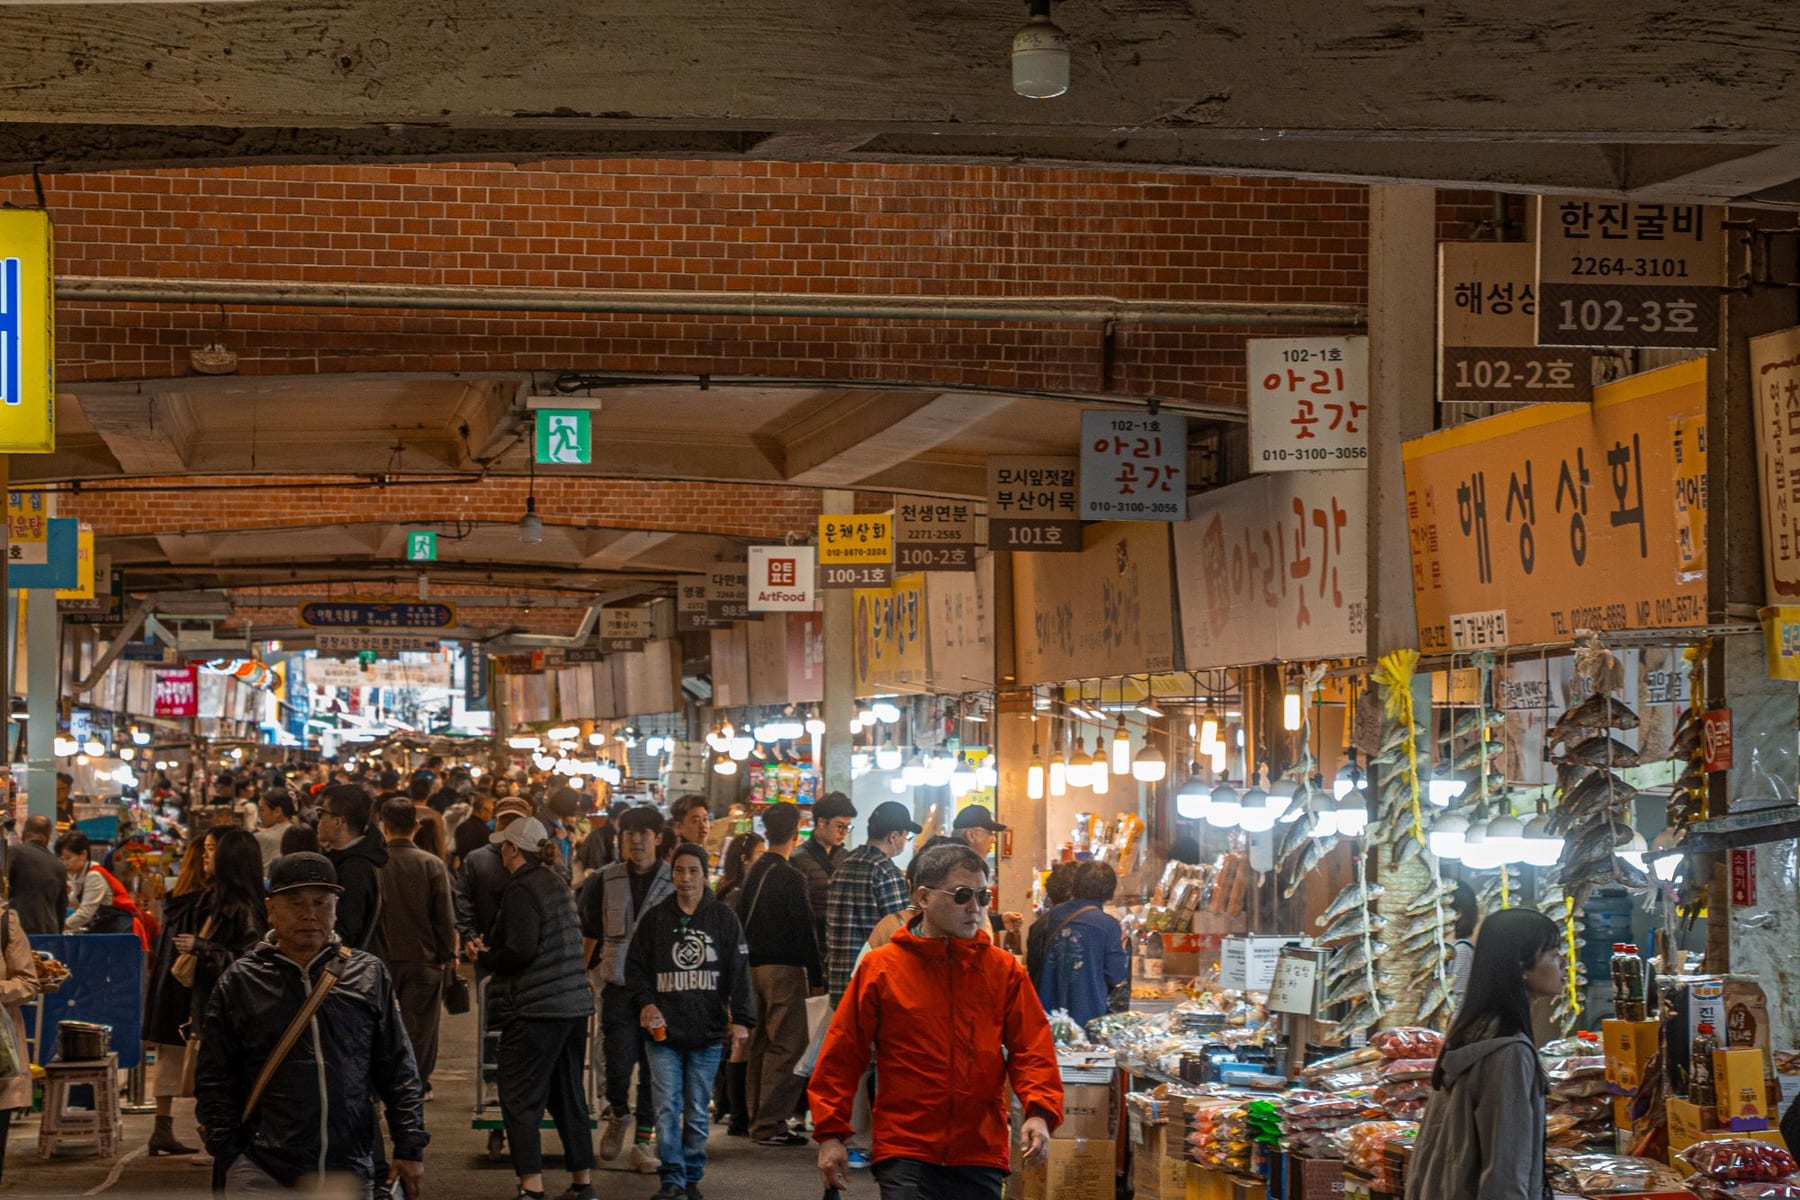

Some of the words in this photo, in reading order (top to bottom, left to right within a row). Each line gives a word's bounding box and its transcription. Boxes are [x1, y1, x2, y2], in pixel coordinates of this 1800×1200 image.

[1559, 202, 1704, 241] 한진굴비
[1570, 257, 1689, 278] 2264-3101
[1558, 299, 1699, 334] 102-3호
[1282, 348, 1343, 363] 102-1호
[1263, 367, 1344, 395] 아리
[1455, 359, 1576, 389] 102-2호
[1111, 420, 1161, 433] 102-1호
[1290, 401, 1368, 440] 곳간
[1093, 436, 1161, 459] 아리
[1262, 446, 1368, 462] 010-3100-3056
[996, 468, 1075, 487] 모시잎젓갈
[1115, 463, 1180, 495] 곳간
[996, 492, 1076, 512] 부산어묵
[1090, 501, 1178, 514] 010-3100-3056
[1456, 433, 1648, 584] 해성상회
[901, 504, 968, 523] 천생연분
[824, 522, 887, 543] 은채상회
[1008, 525, 1063, 546] 101호
[901, 549, 967, 566] 100-2호
[1232, 495, 1348, 631] 아리곳간
[827, 567, 885, 584] 100-1호
[758, 591, 806, 602] ArtFood
